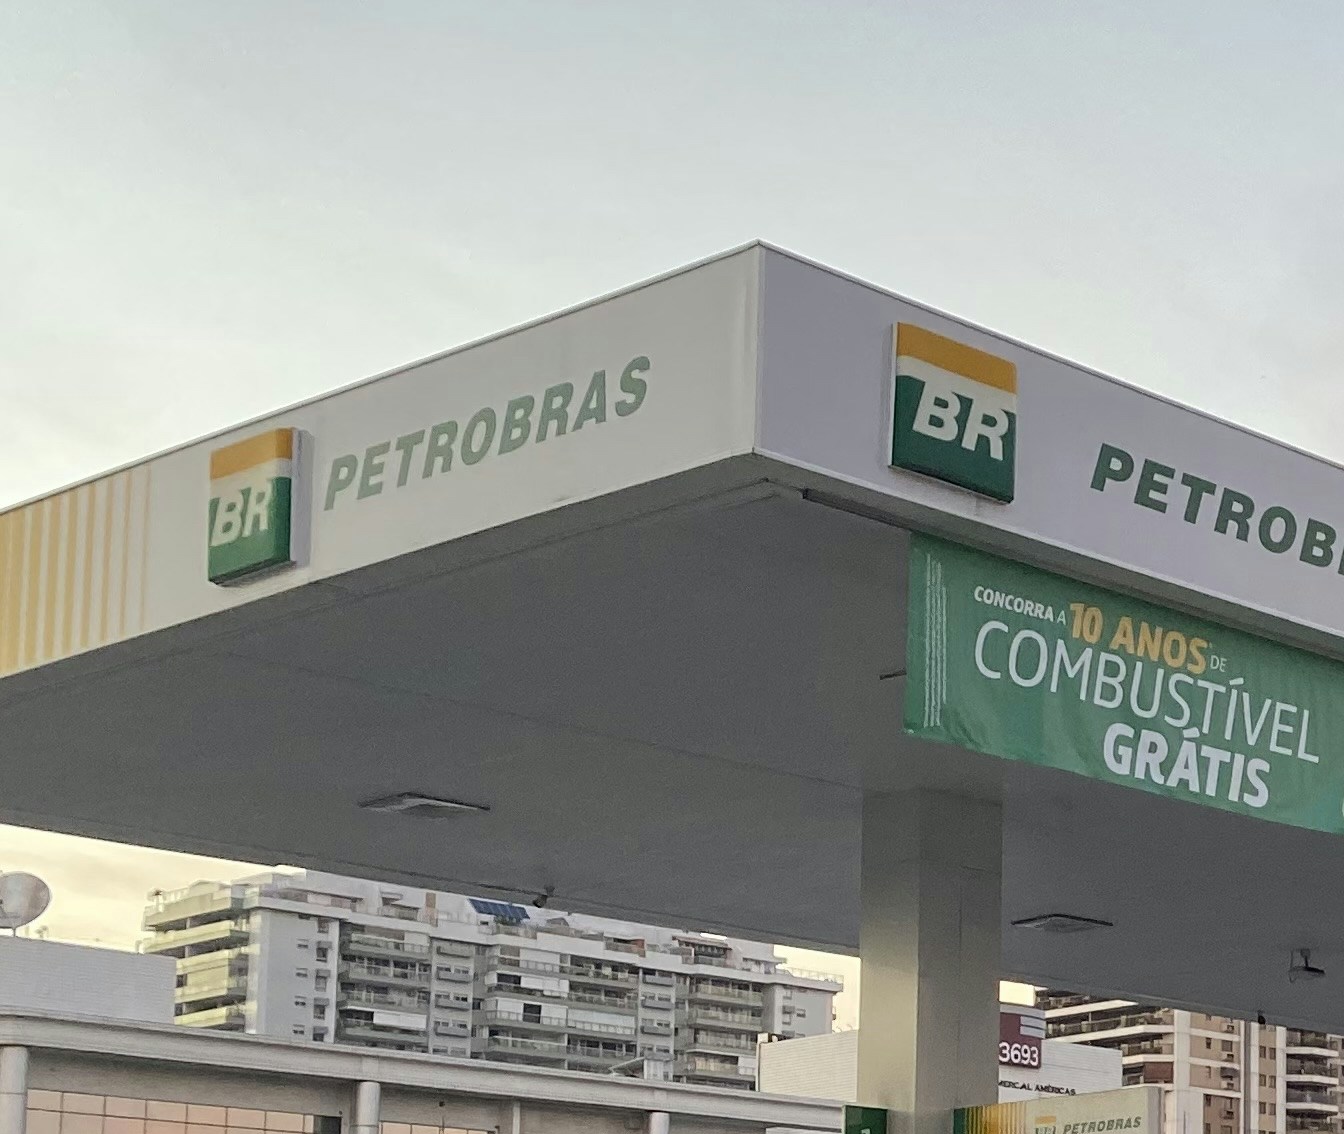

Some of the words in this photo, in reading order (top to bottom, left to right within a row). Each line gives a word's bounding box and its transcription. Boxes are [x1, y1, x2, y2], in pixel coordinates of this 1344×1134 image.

[324, 355, 651, 511] PETROBRAS
[912, 384, 1011, 461] BR
[210, 484, 273, 547] BR
[974, 585, 1054, 622] CONCORRA
[1056, 610, 1066, 626] A
[1070, 602, 1103, 644] 10
[1110, 617, 1208, 674] ANOS
[1210, 654, 1227, 672] DE
[975, 620, 1319, 763] COMBUSTÍVEL
[1103, 723, 1270, 808] GRÁTIS
[999, 1041, 1039, 1066] 3693
